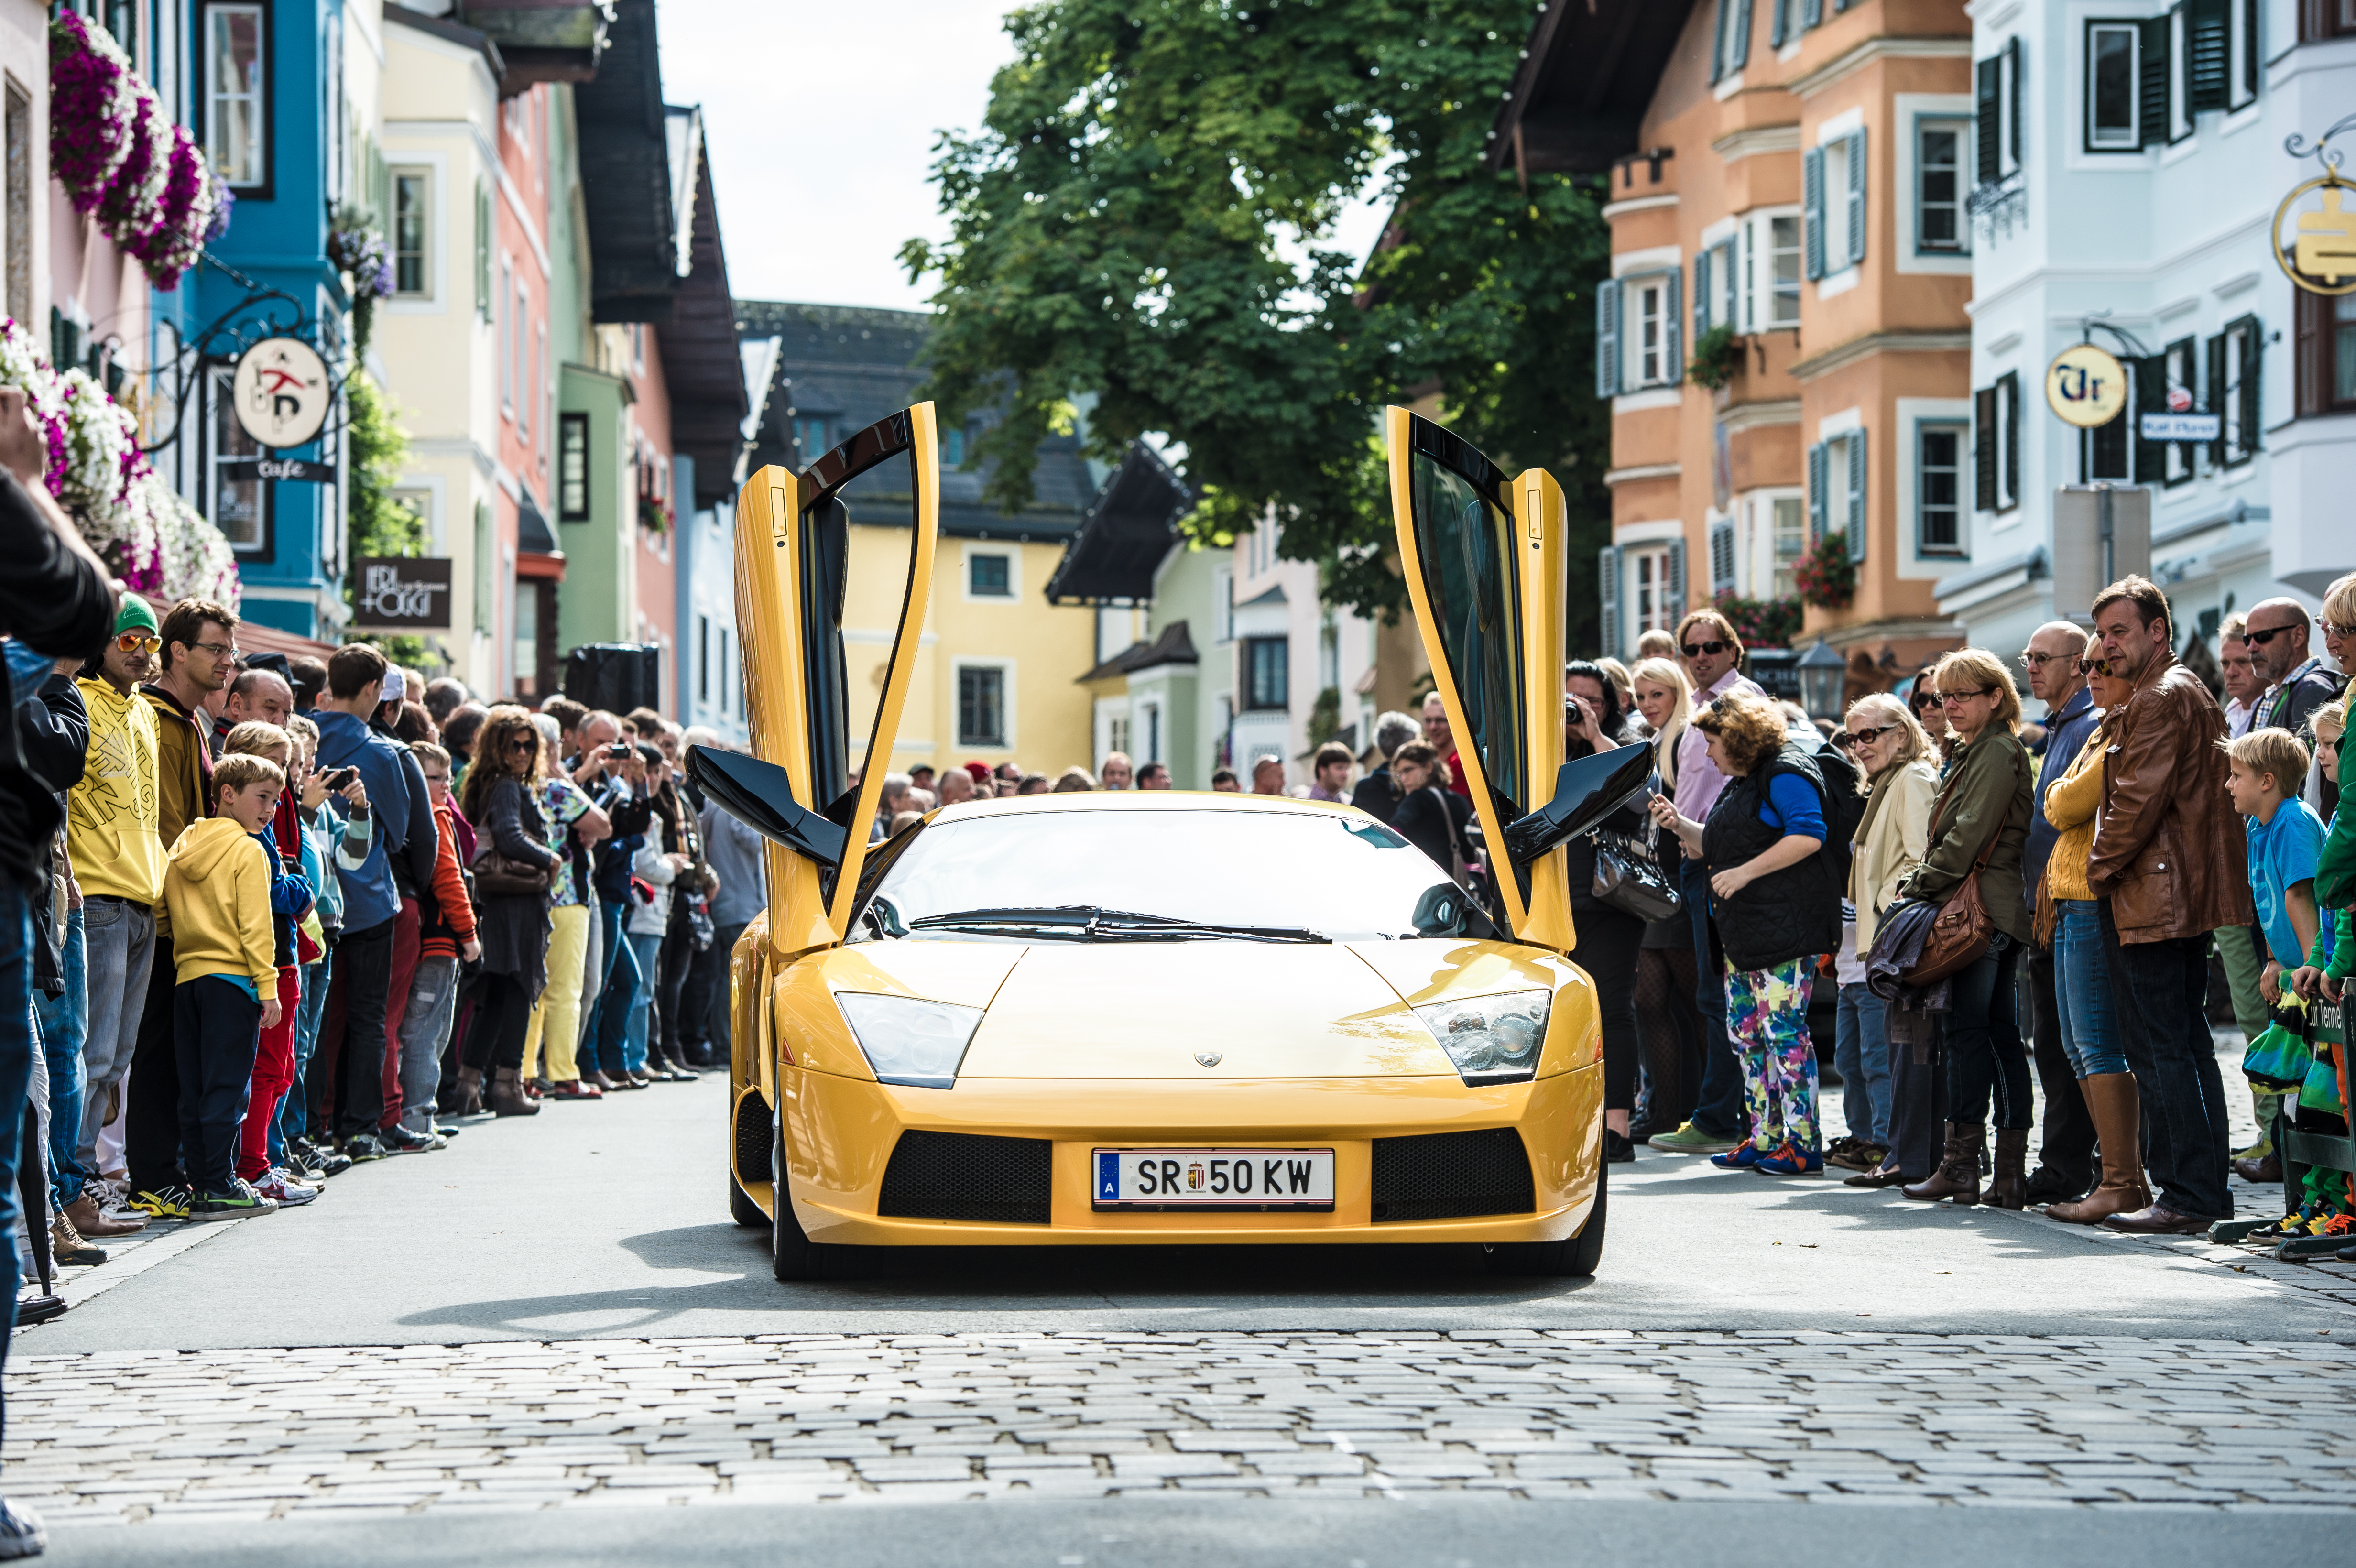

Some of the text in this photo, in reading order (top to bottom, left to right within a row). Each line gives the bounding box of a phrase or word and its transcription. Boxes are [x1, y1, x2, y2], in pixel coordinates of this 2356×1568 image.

[2309, 999, 2341, 1029] ur Tenne
[1105, 1183, 1114, 1193] A
[1139, 1159, 1180, 1194] SR
[1264, 1159, 1312, 1194] KW
